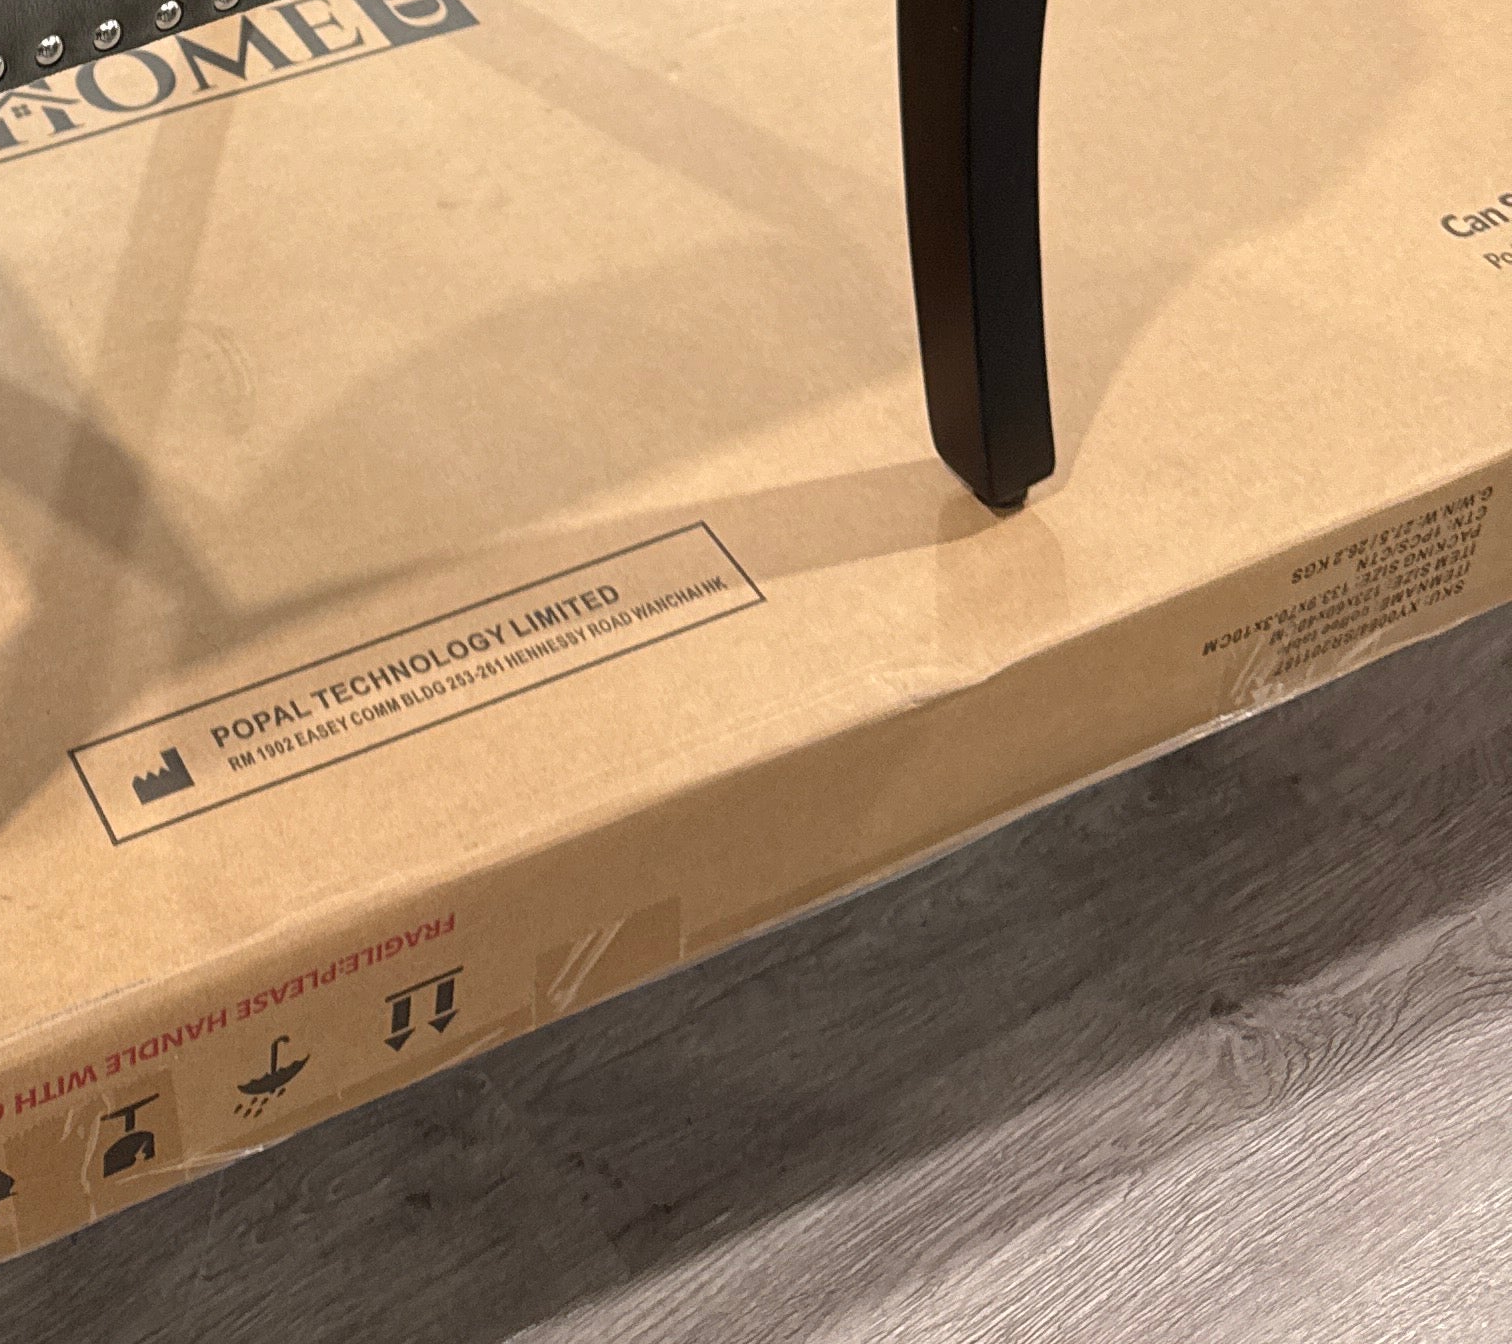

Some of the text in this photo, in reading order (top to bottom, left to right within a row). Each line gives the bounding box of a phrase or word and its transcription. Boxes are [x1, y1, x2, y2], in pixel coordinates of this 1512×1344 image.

[1441, 207, 1509, 237] Can
[1355, 503, 1488, 573] CTN: 1PCS/CTN
[1402, 522, 1482, 569] PACKING
[1433, 541, 1476, 571] ITEM
[1290, 555, 1329, 585] KGS
[1353, 558, 1399, 590] SIZE:
[211, 581, 620, 748] POPAL TECHNOLOGY LIMITED
[227, 750, 257, 772] RM
[255, 735, 295, 762] 1902
[294, 715, 349, 747] EASEY
[348, 696, 402, 727] COMM
[399, 679, 447, 708] BLDG
[504, 627, 587, 669] HENNESSY
[586, 610, 633, 638] ROAD
[105, 1007, 227, 1077] HANDLE
[16, 1061, 96, 1114] WITH
